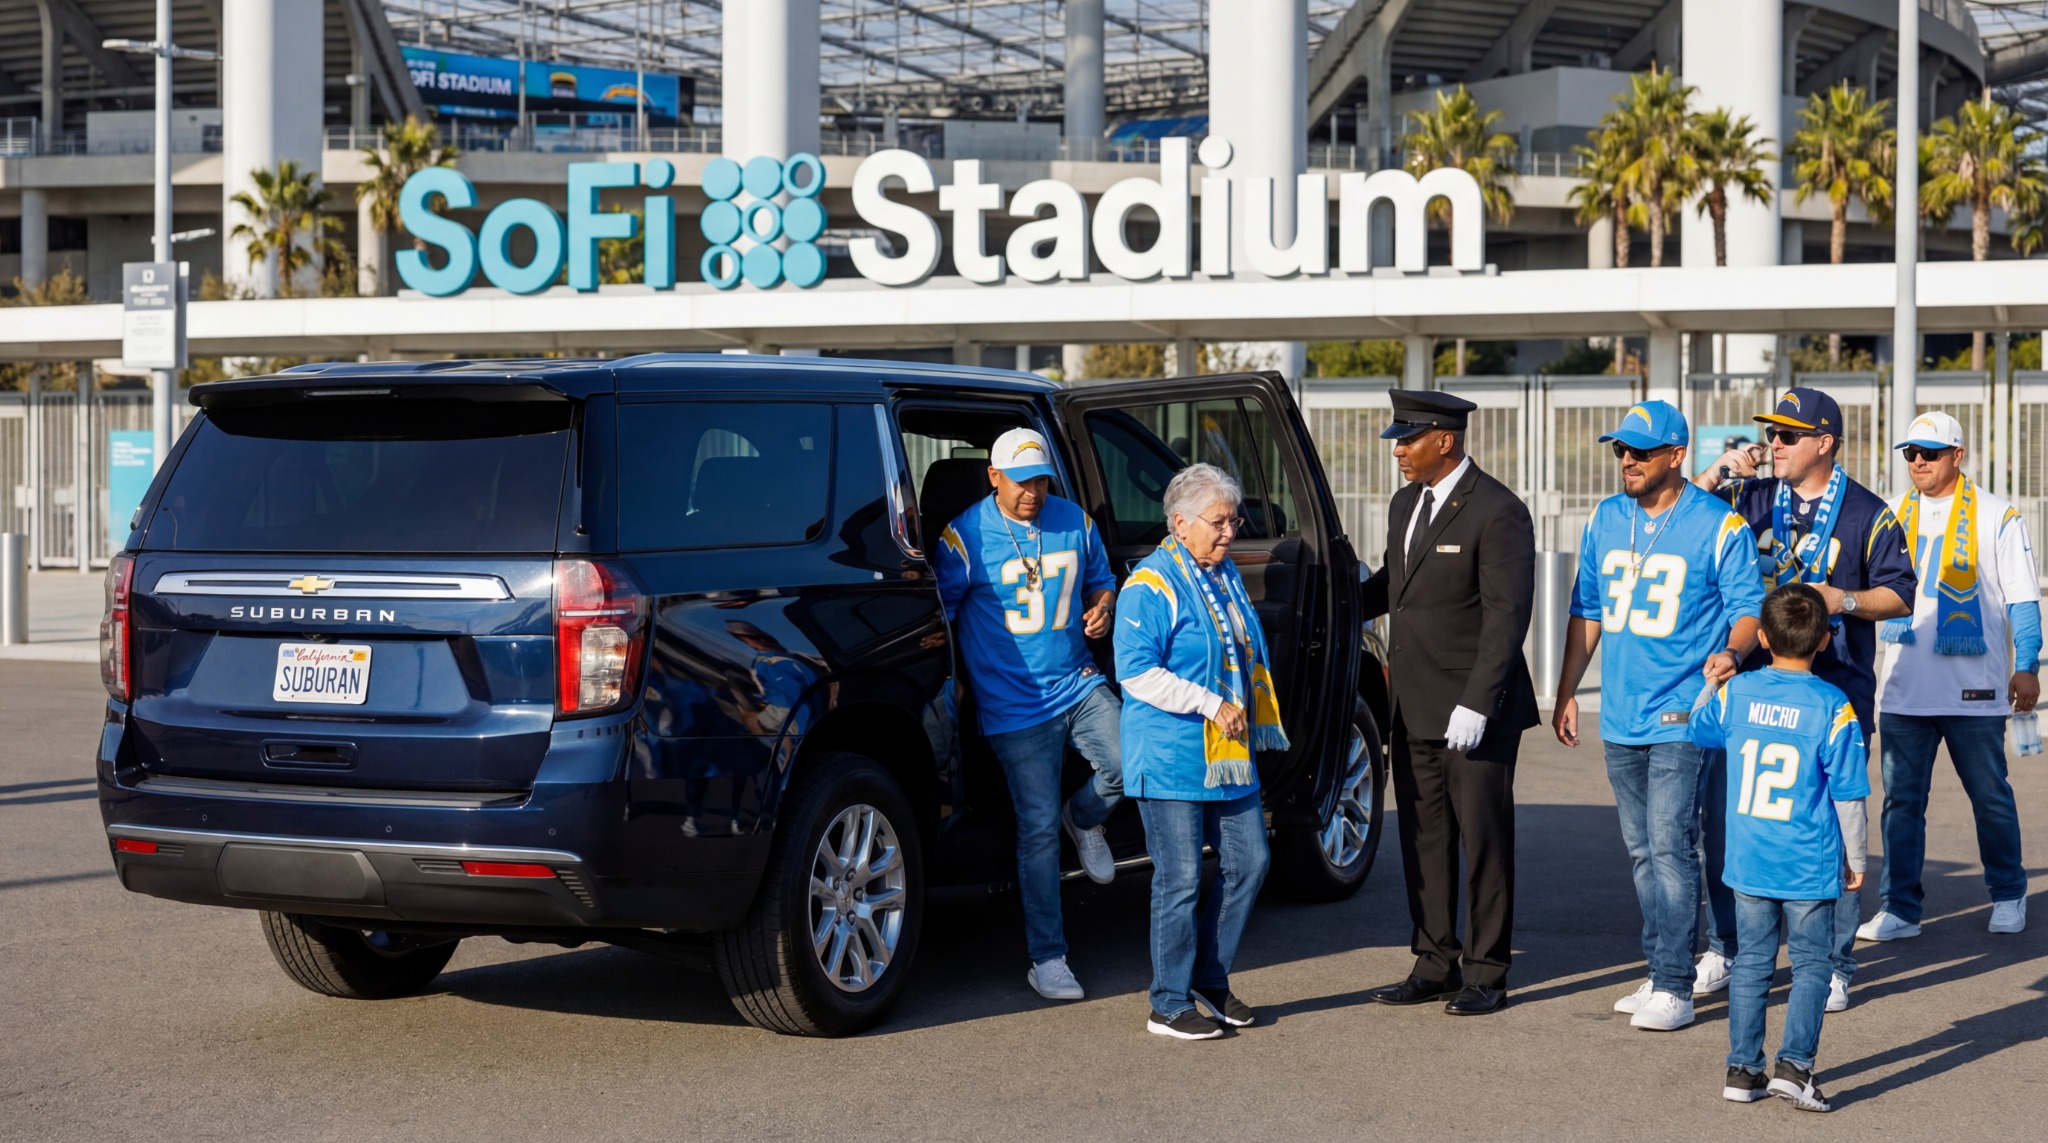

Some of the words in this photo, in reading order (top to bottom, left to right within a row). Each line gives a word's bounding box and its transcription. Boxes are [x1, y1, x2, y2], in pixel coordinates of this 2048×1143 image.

[410, 69, 435, 88] OFI
[437, 72, 512, 96] STADIUM
[395, 157, 676, 297] SoFi
[848, 136, 1486, 286] Stadium
[230, 606, 396, 622] SUBURBAN
[1001, 549, 1079, 635] 37
[1601, 549, 1687, 638] 33
[280, 666, 361, 694] SUBURAN
[296, 648, 353, 666] California
[1737, 738, 1800, 822] 12
